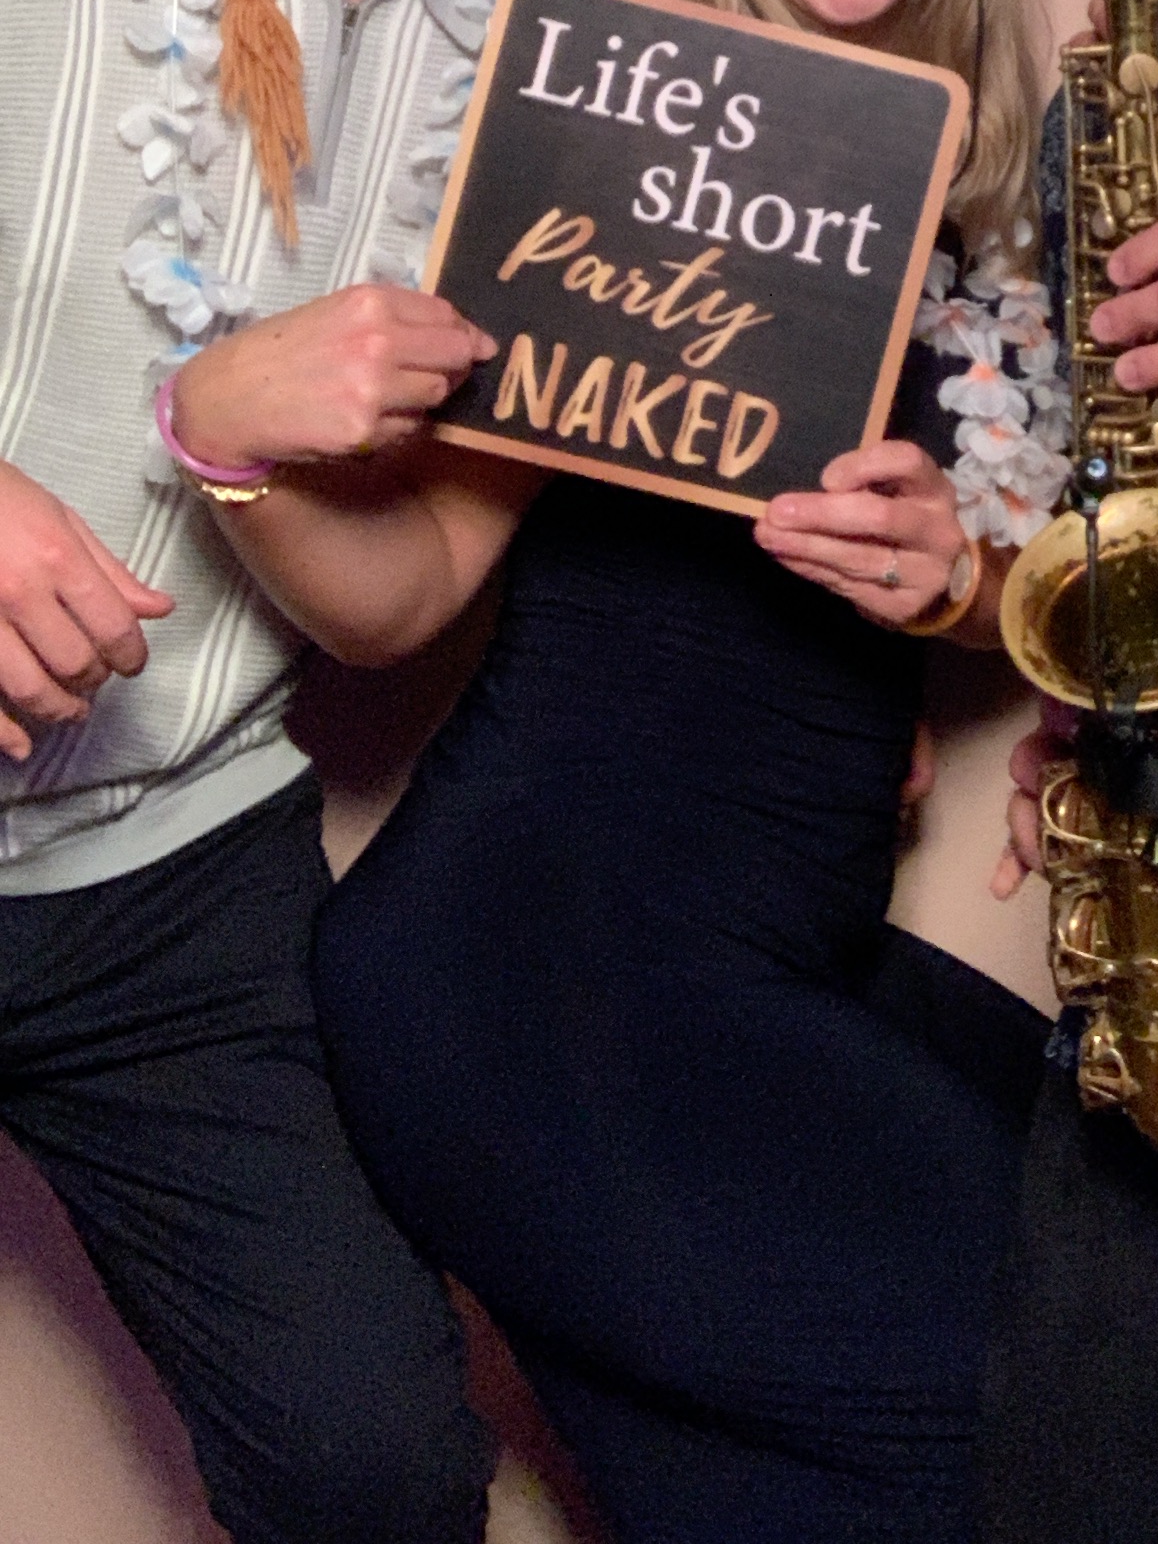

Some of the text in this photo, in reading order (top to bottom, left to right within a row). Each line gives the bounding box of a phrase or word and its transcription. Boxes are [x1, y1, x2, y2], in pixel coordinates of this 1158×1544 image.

[519, 17, 761, 150] Life's
[632, 146, 882, 276] short
[493, 333, 780, 478] NAKED
